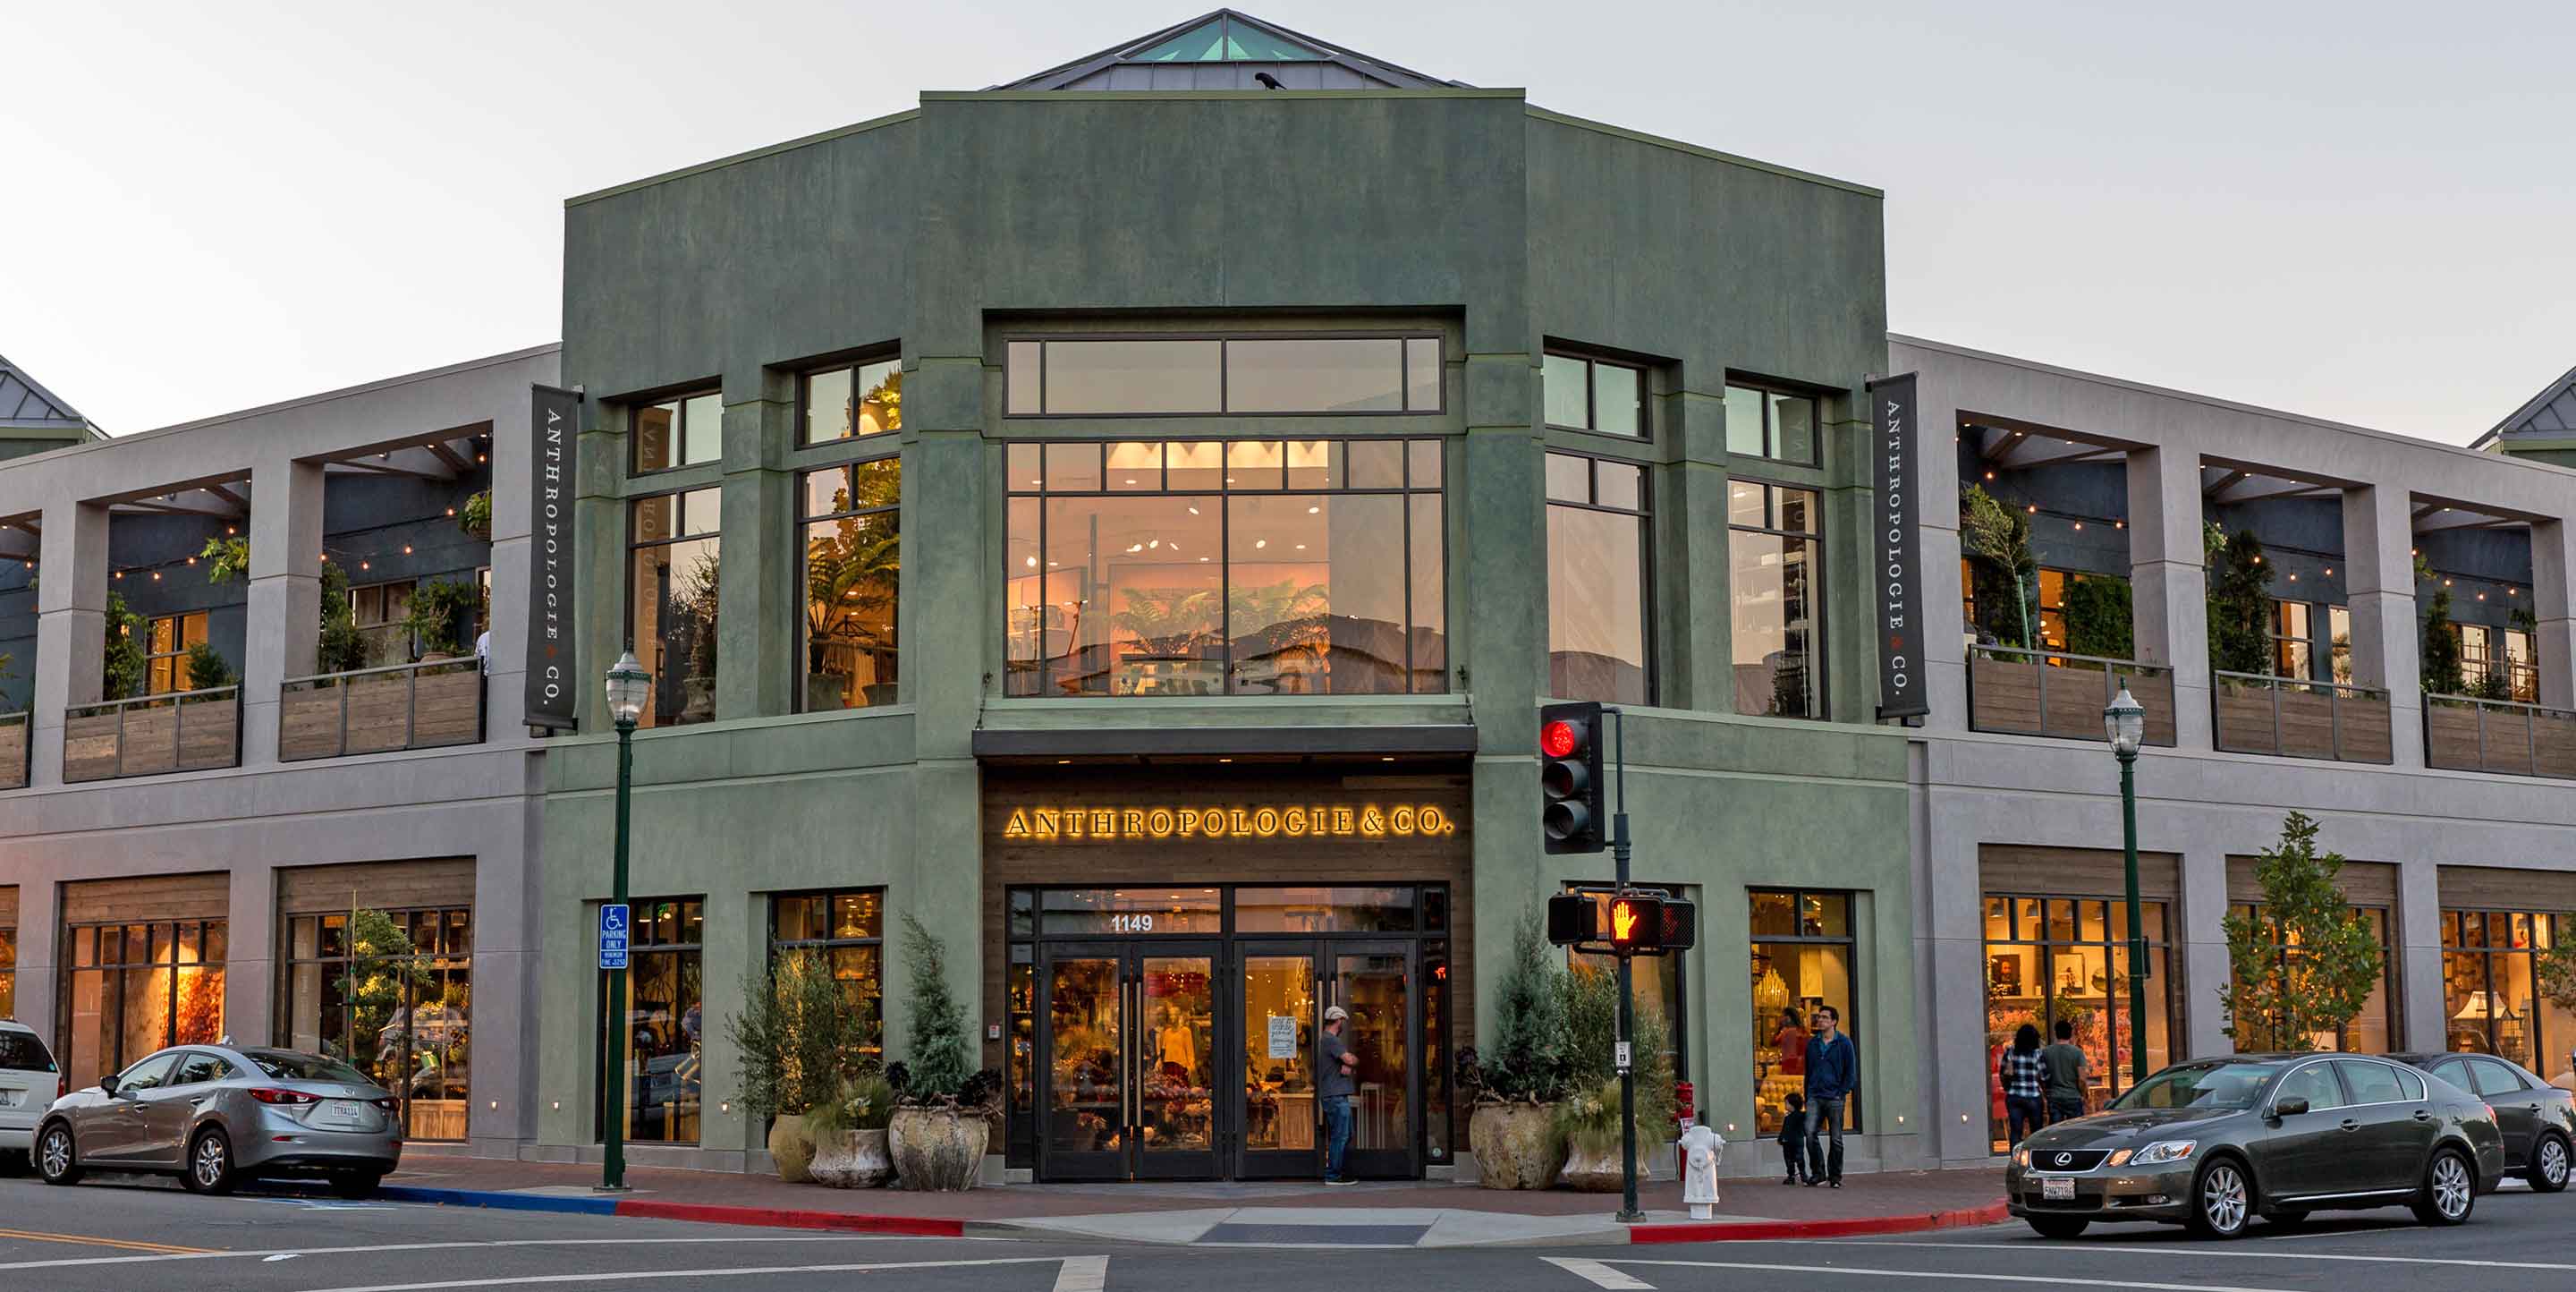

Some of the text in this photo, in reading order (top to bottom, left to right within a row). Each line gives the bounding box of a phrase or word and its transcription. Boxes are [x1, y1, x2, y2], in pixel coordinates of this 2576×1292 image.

[546, 407, 562, 639] ANTHROPOLOGIE
[1888, 400, 1903, 629] ANTHROPOLOGIE
[544, 666, 559, 705] CO.
[1892, 655, 1907, 695] CO.
[602, 930, 626, 939] PARKING
[1111, 914, 1153, 931] 1149
[606, 940, 621, 949] ONLY
